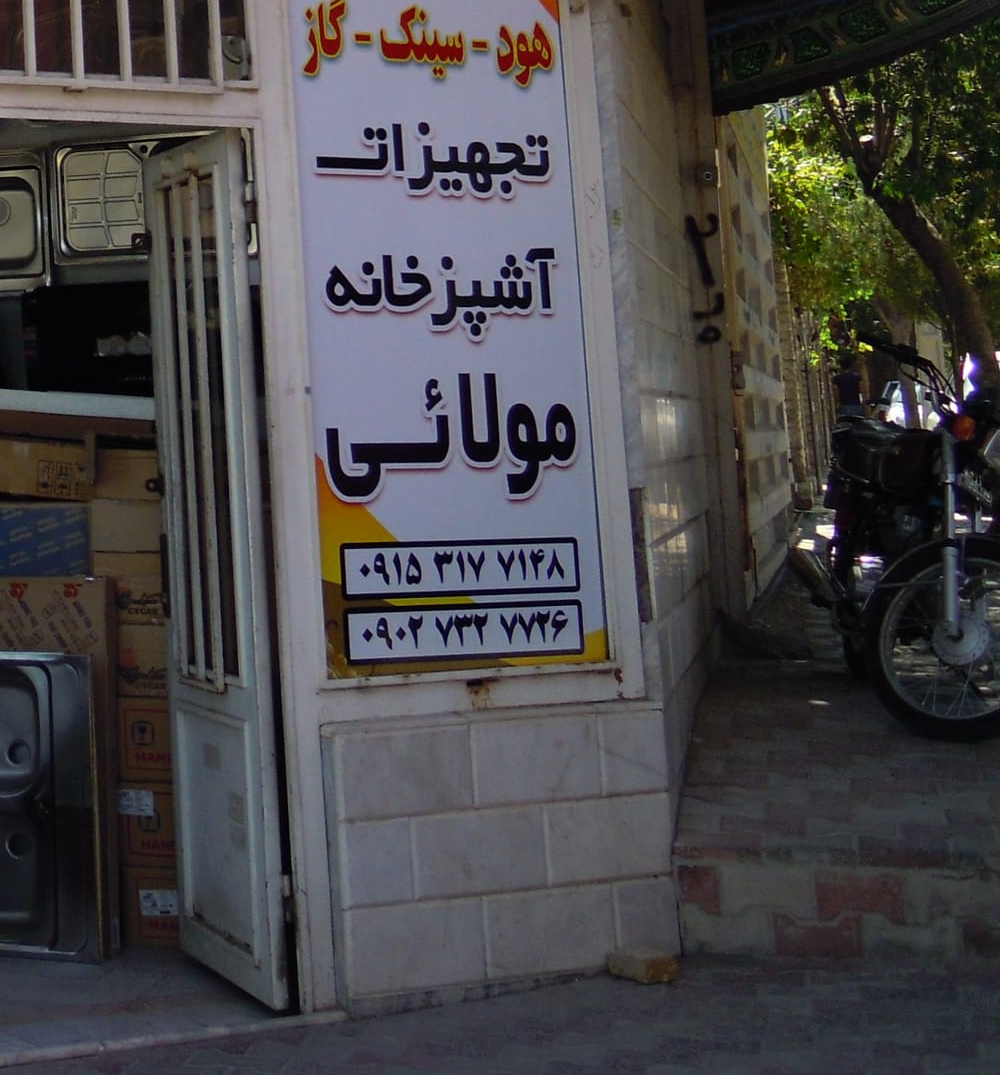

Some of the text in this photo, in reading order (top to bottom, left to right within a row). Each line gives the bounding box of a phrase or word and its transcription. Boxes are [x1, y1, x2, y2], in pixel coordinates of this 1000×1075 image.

[379, 6, 465, 77] سینک
[497, 21, 553, 85] هود
[315, 121, 550, 195] تجهیزات
[325, 247, 555, 337] آشپزخانه
[325, 372, 577, 498] مولائی
[358, 548, 565, 587] ۰۹۱۵ ۳۱۷ ۷۱۴۸
[361, 609, 569, 650] ۰۹۰۲ ۷۳۲ ۷۷۲۶
